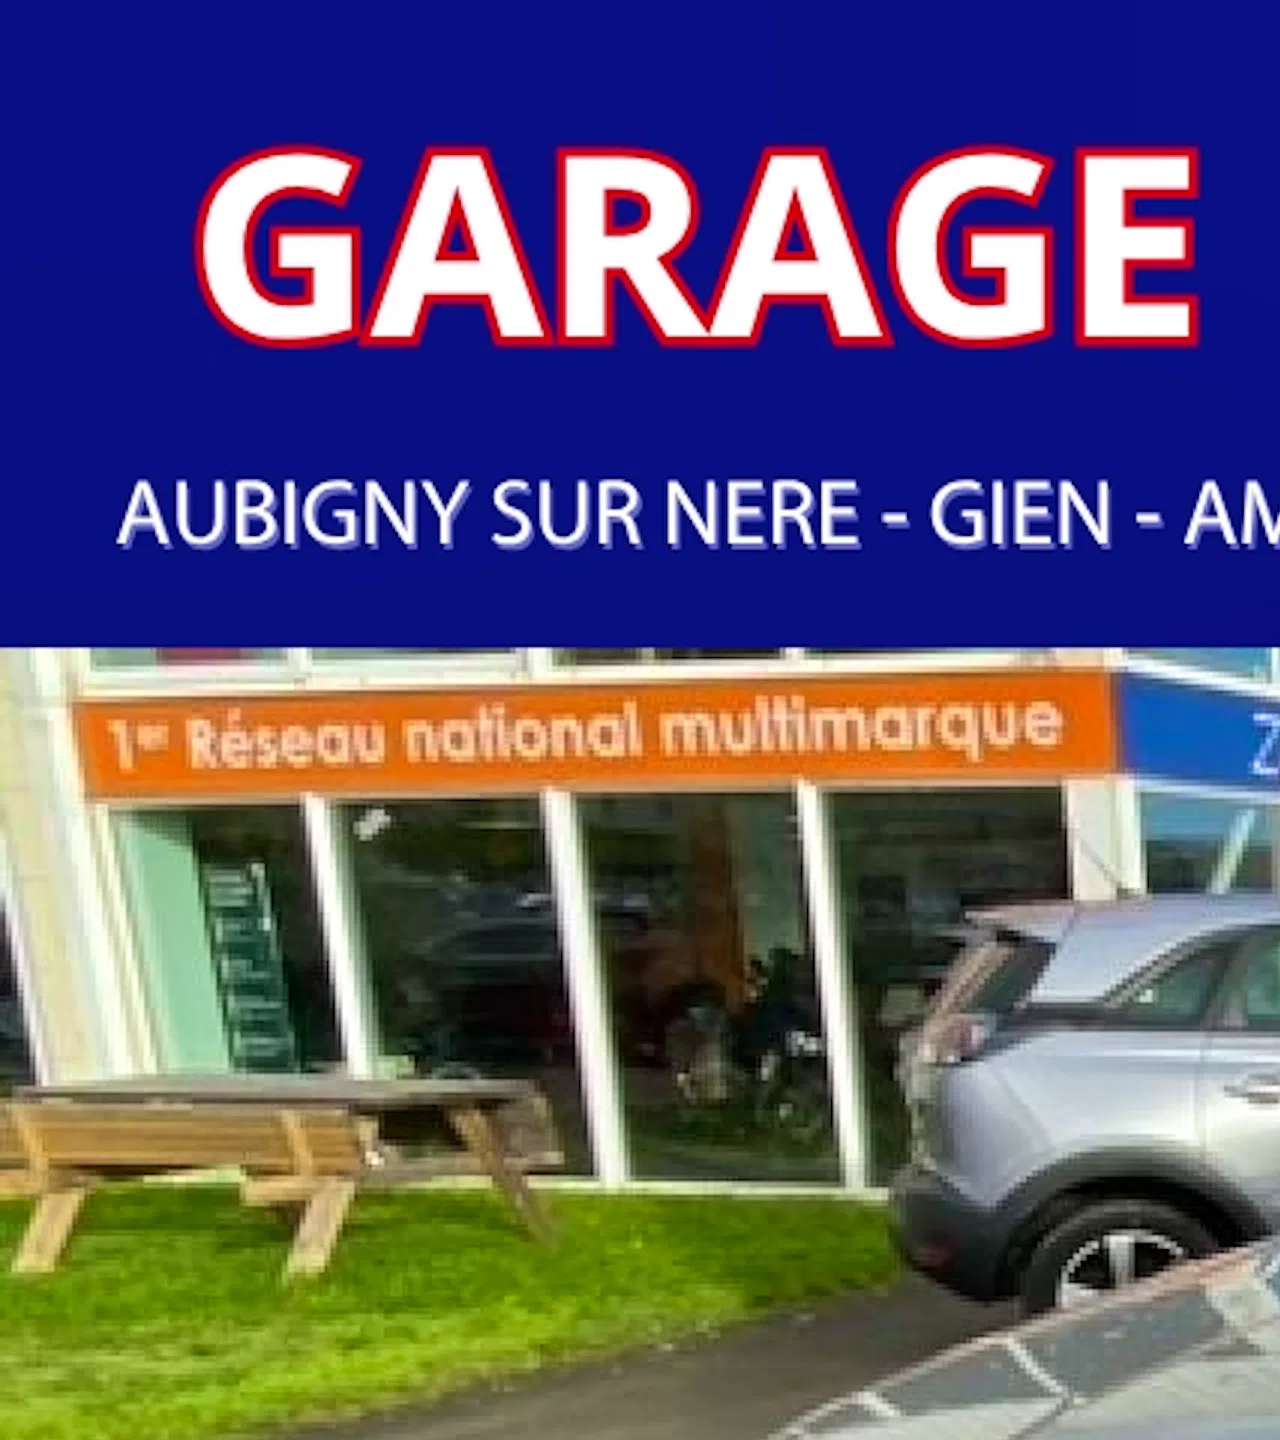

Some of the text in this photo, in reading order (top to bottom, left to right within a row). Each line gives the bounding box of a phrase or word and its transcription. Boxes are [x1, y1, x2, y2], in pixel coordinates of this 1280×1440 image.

[185, 706, 386, 770] Réseau
[403, 698, 643, 764] national
[659, 695, 1064, 763] multimarque
